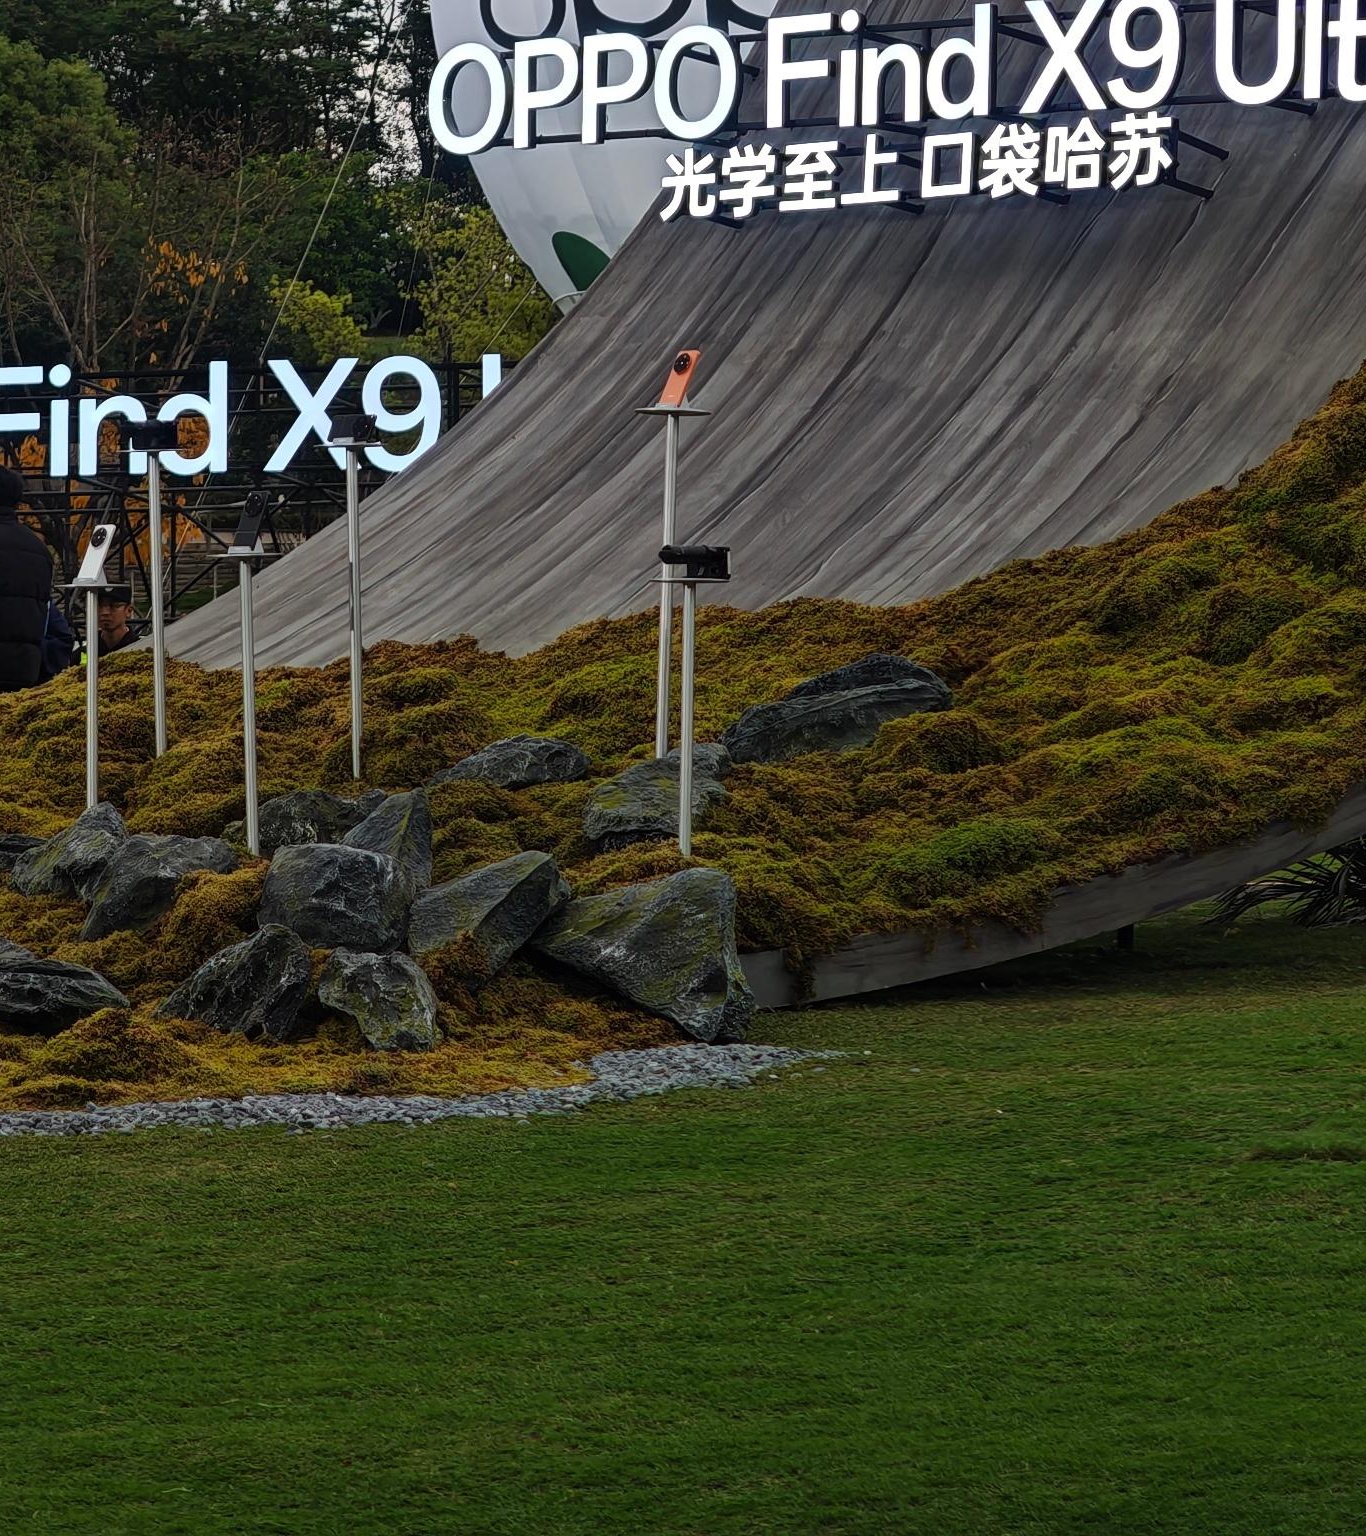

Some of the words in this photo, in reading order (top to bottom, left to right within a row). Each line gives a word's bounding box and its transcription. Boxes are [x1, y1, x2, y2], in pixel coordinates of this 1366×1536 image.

[428, 26, 737, 155] OPPO
[766, 3, 991, 129] Find
[659, 133, 899, 222] 光学至上
[921, 111, 1173, 198] 口袋哈苏
[263, 355, 442, 473] X9
